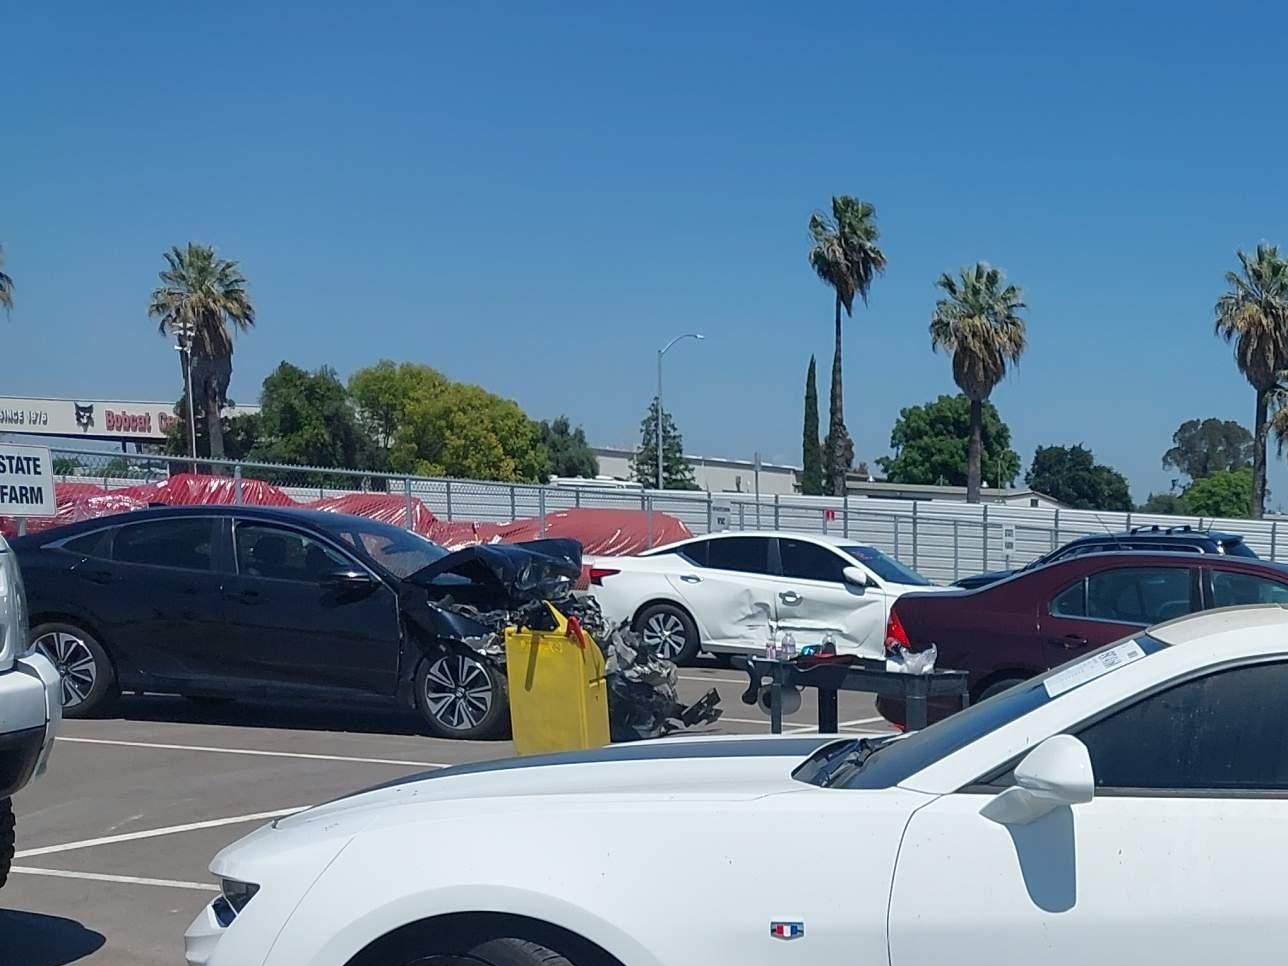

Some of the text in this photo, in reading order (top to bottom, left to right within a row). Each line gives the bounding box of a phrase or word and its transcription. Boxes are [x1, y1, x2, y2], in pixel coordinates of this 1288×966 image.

[105, 409, 152, 433] Bobcat
[0, 454, 42, 475] STATE
[0, 484, 44, 504] FARM
